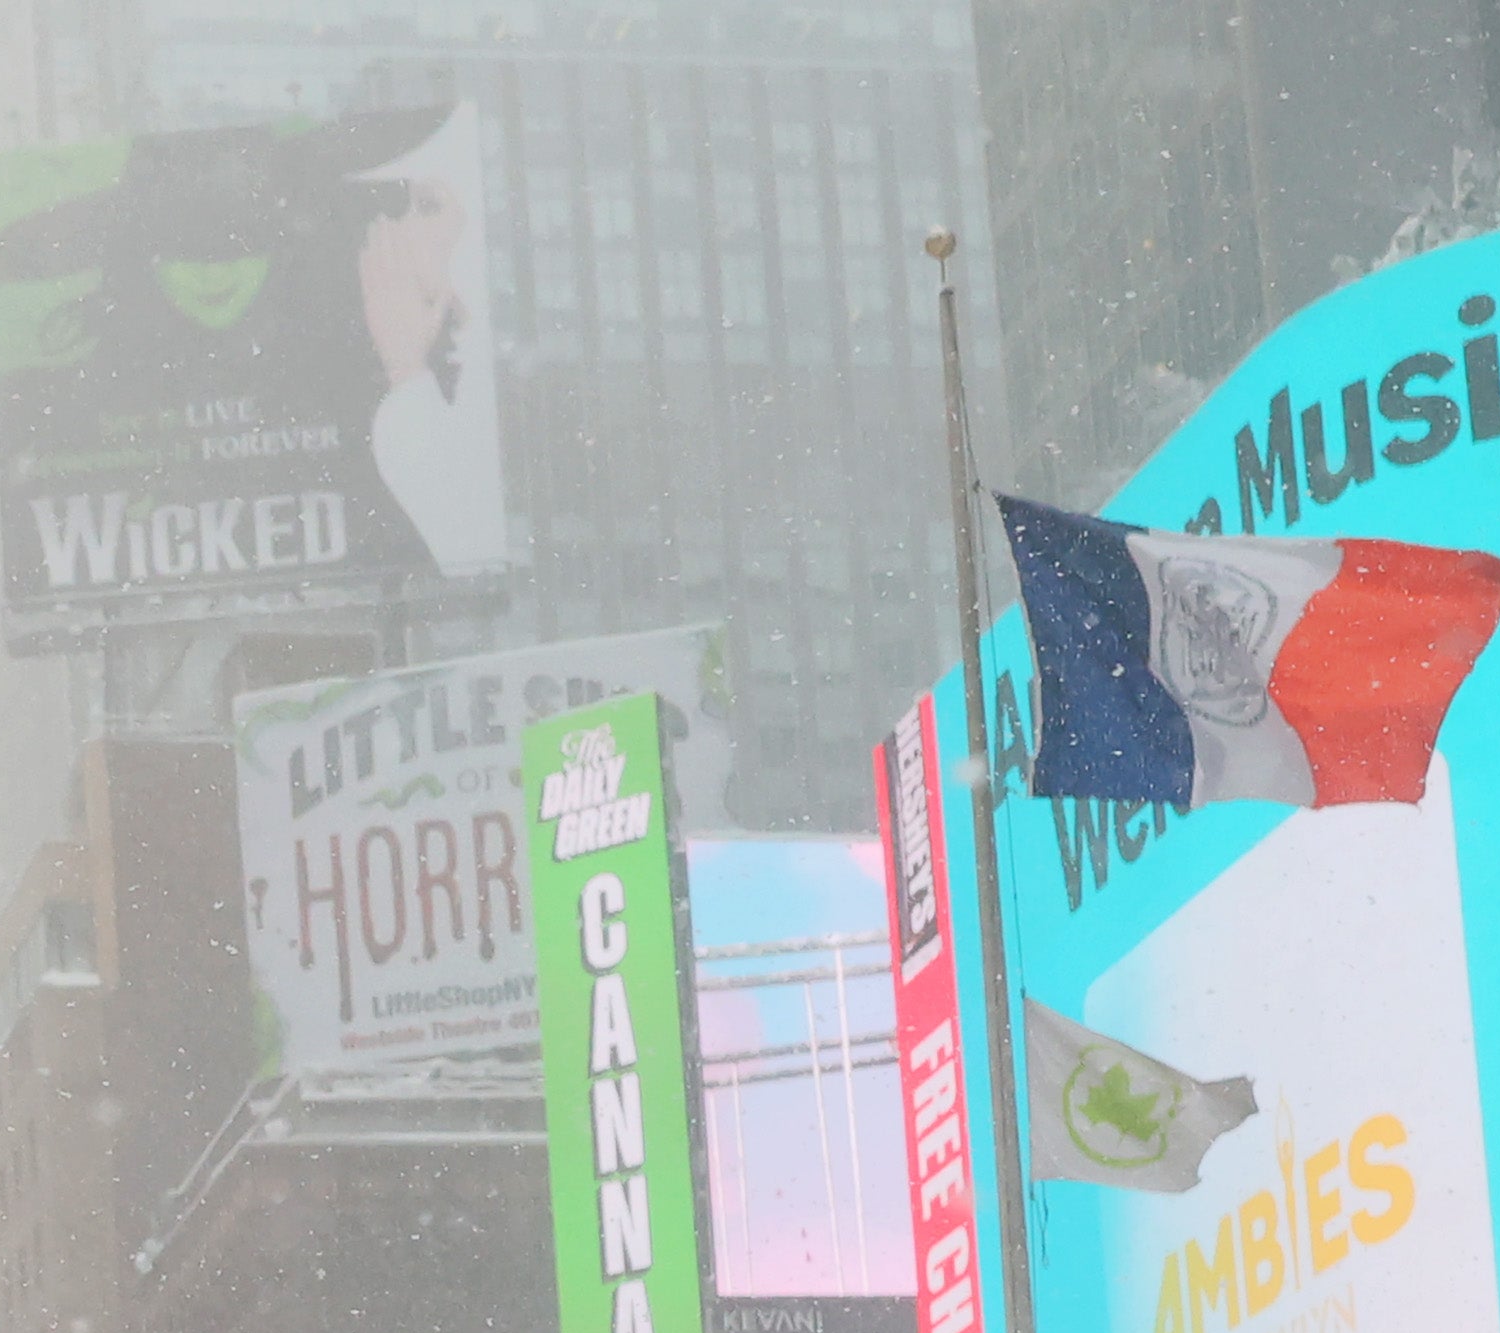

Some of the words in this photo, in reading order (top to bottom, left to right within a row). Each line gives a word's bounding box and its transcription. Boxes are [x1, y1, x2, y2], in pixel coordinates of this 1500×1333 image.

[289, 674, 506, 820] LITTLE
[538, 752, 627, 823] DAILY
[552, 791, 652, 859] GREEN
[911, 1017, 975, 1222] FREE
